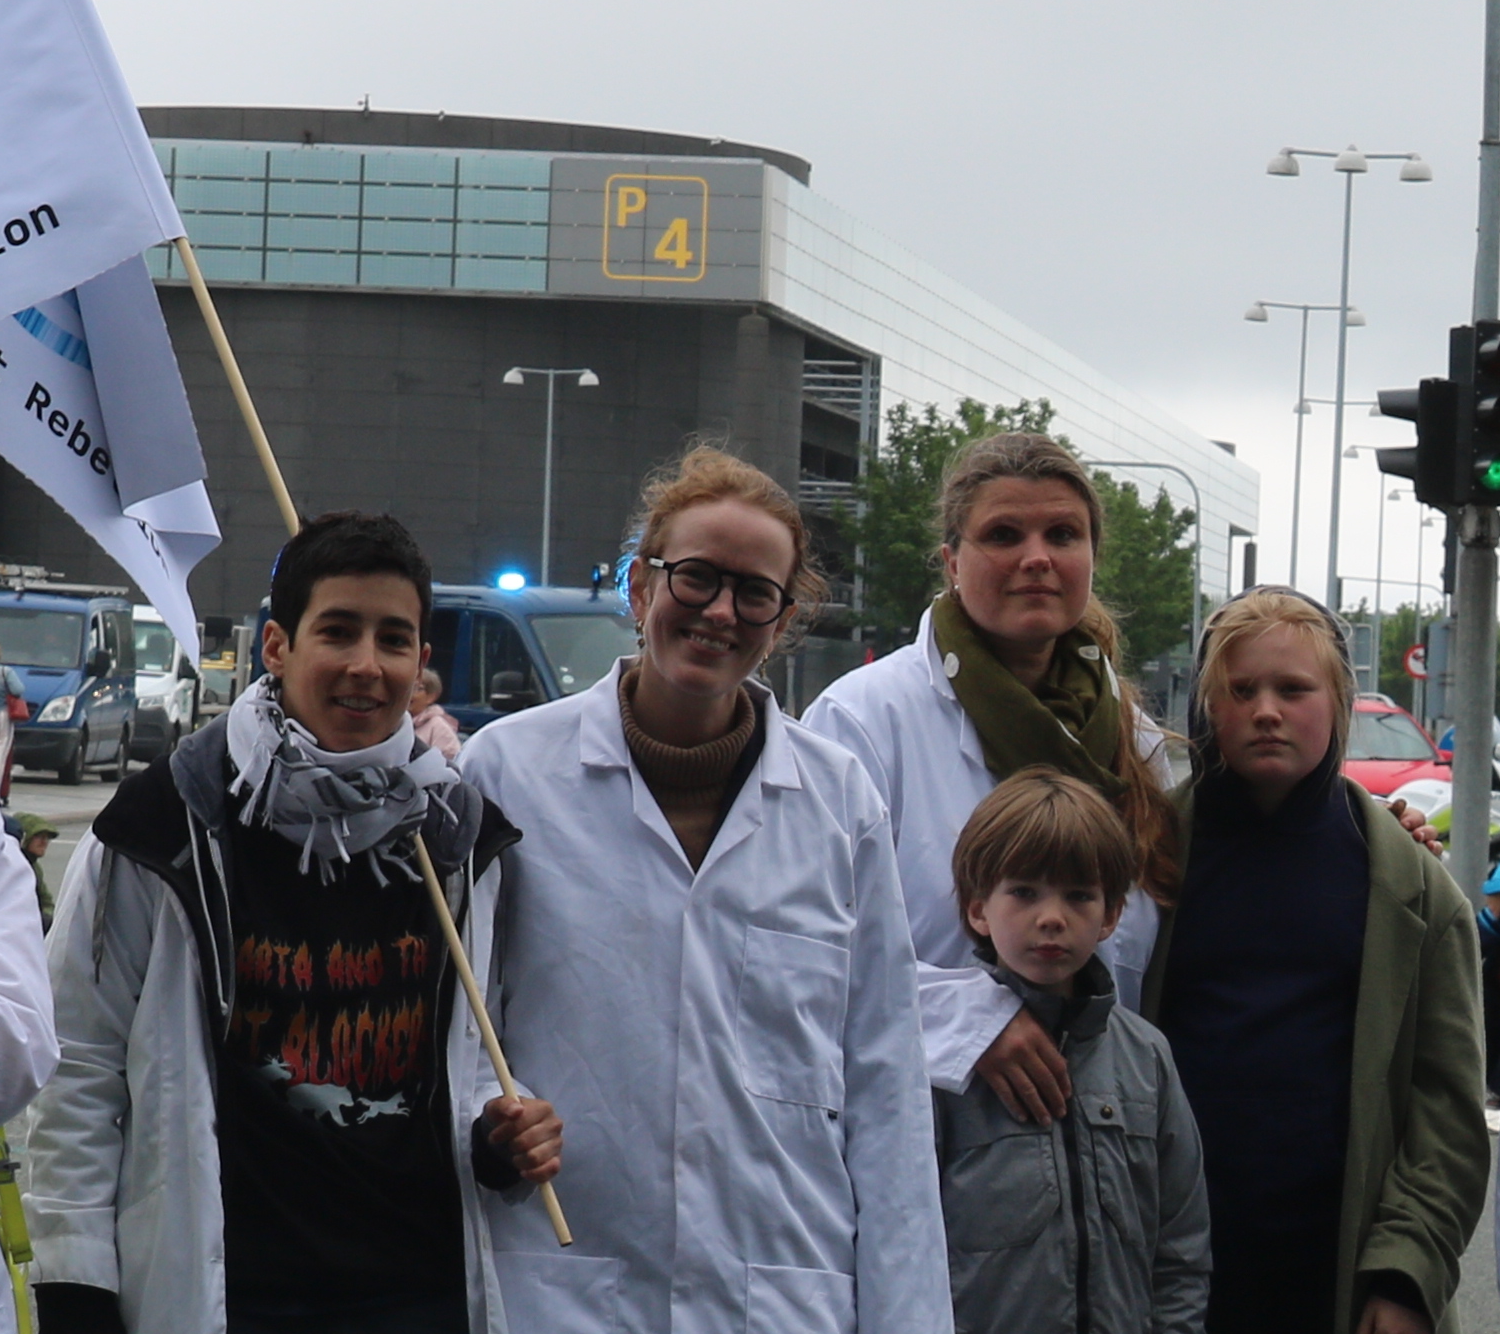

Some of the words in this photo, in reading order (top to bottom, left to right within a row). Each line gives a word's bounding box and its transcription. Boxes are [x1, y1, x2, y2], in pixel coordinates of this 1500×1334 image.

[617, 186, 647, 227] P
[654, 218, 693, 269] 4
[326, 937, 385, 992] AND
